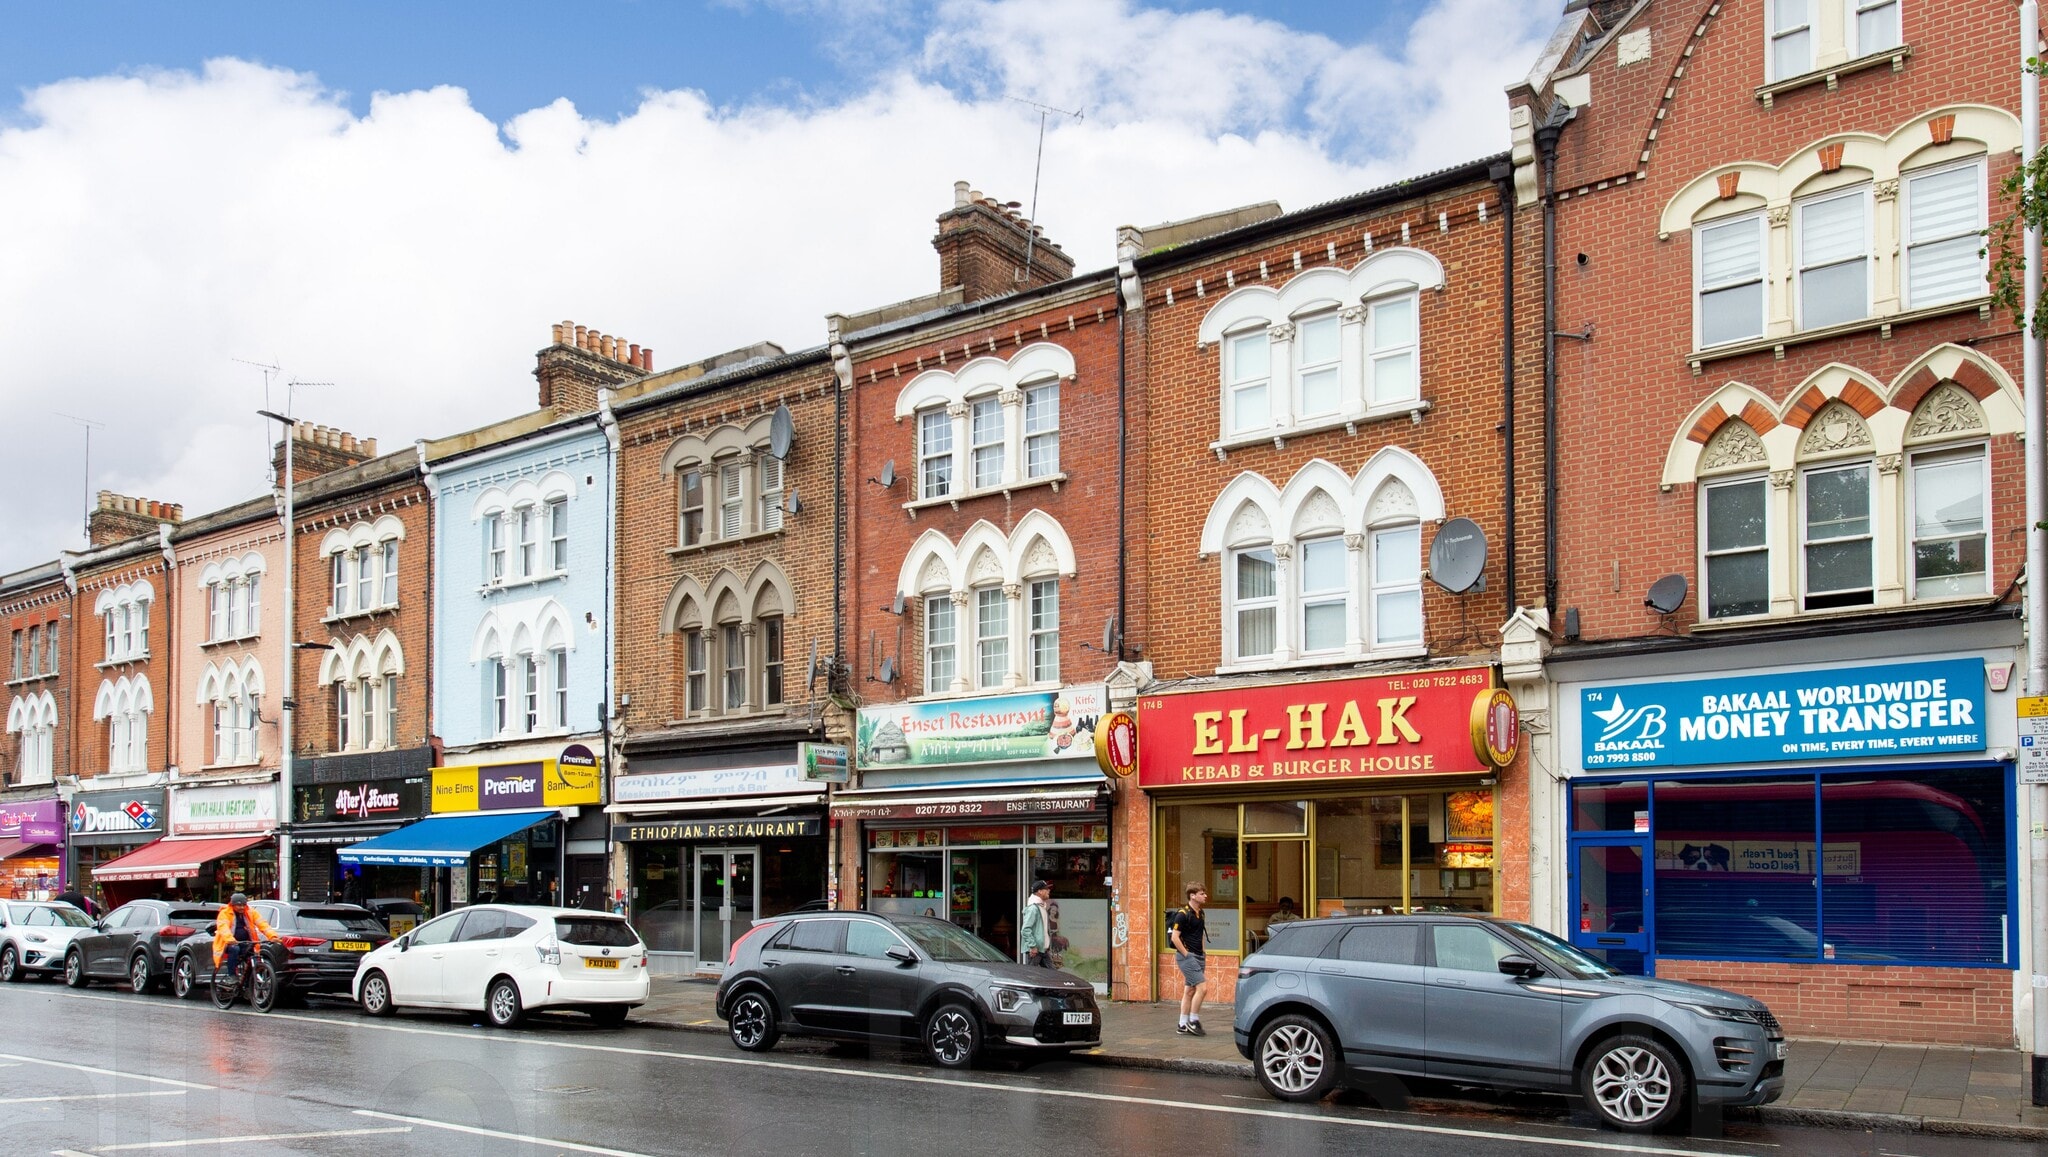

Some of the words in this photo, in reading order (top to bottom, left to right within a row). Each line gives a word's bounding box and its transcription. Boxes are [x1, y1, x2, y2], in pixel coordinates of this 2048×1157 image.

[1388, 680, 1410, 690] TEL:
[1413, 678, 1430, 689] 020
[1433, 676, 1456, 687] 7622
[1460, 674, 1484, 685] 4683
[1075, 695, 1096, 705] Kitfo
[1587, 692, 1602, 702] 174
[1703, 690, 1791, 714] BAKAAL
[1796, 678, 1946, 707] WORLDWIDE
[1142, 700, 1156, 709] 174
[1157, 700, 1162, 709] B
[900, 714, 944, 734] Enset
[950, 707, 1046, 730] Restaurant
[1192, 696, 1422, 755] EL-HAK
[1680, 710, 1789, 741] MONEY
[1799, 697, 1974, 735] TRANSFER
[1594, 739, 1665, 751] BAKAAL
[1783, 743, 1797, 753] ON
[1799, 741, 1829, 753] TIME,
[1831, 739, 1865, 751] EVERY
[1867, 737, 1897, 750] TIME,
[1900, 736, 1933, 747] EVERY
[1935, 733, 1978, 746] WHERE
[2024, 738, 2031, 746] P
[563, 755, 593, 765] Premier
[1490, 744, 1514, 763] BURGERS
[1587, 755, 1604, 764] 020
[1606, 753, 1630, 763] 7993
[1632, 752, 1656, 762] 8500
[1182, 764, 1241, 780] KEBAB
[1248, 764, 1264, 777] &
[1273, 759, 1352, 776] BURGER
[1360, 755, 1434, 773] HOUSE
[436, 785, 453, 795] Nine
[455, 783, 473, 794] Elms
[484, 776, 537, 796] Premier
[618, 789, 671, 800] Meskerem
[678, 785, 736, 796] Restaurant
[738, 784, 746, 792] &
[748, 783, 767, 792] Bar
[190, 802, 208, 817] WINTA
[209, 801, 224, 816] HALAL
[225, 800, 241, 815] MEAT
[242, 799, 256, 815] SHOP
[335, 789, 360, 815] After
[367, 789, 399, 808] Hours
[915, 805, 938, 815] 0207
[939, 804, 957, 814] 720
[959, 803, 982, 813] 8322
[1006, 801, 1033, 811] ENSET
[1034, 799, 1090, 810] RESTAURANT
[631, 826, 701, 840] ETHIOPIAN
[1066, 1014, 1080, 1022] LT72
